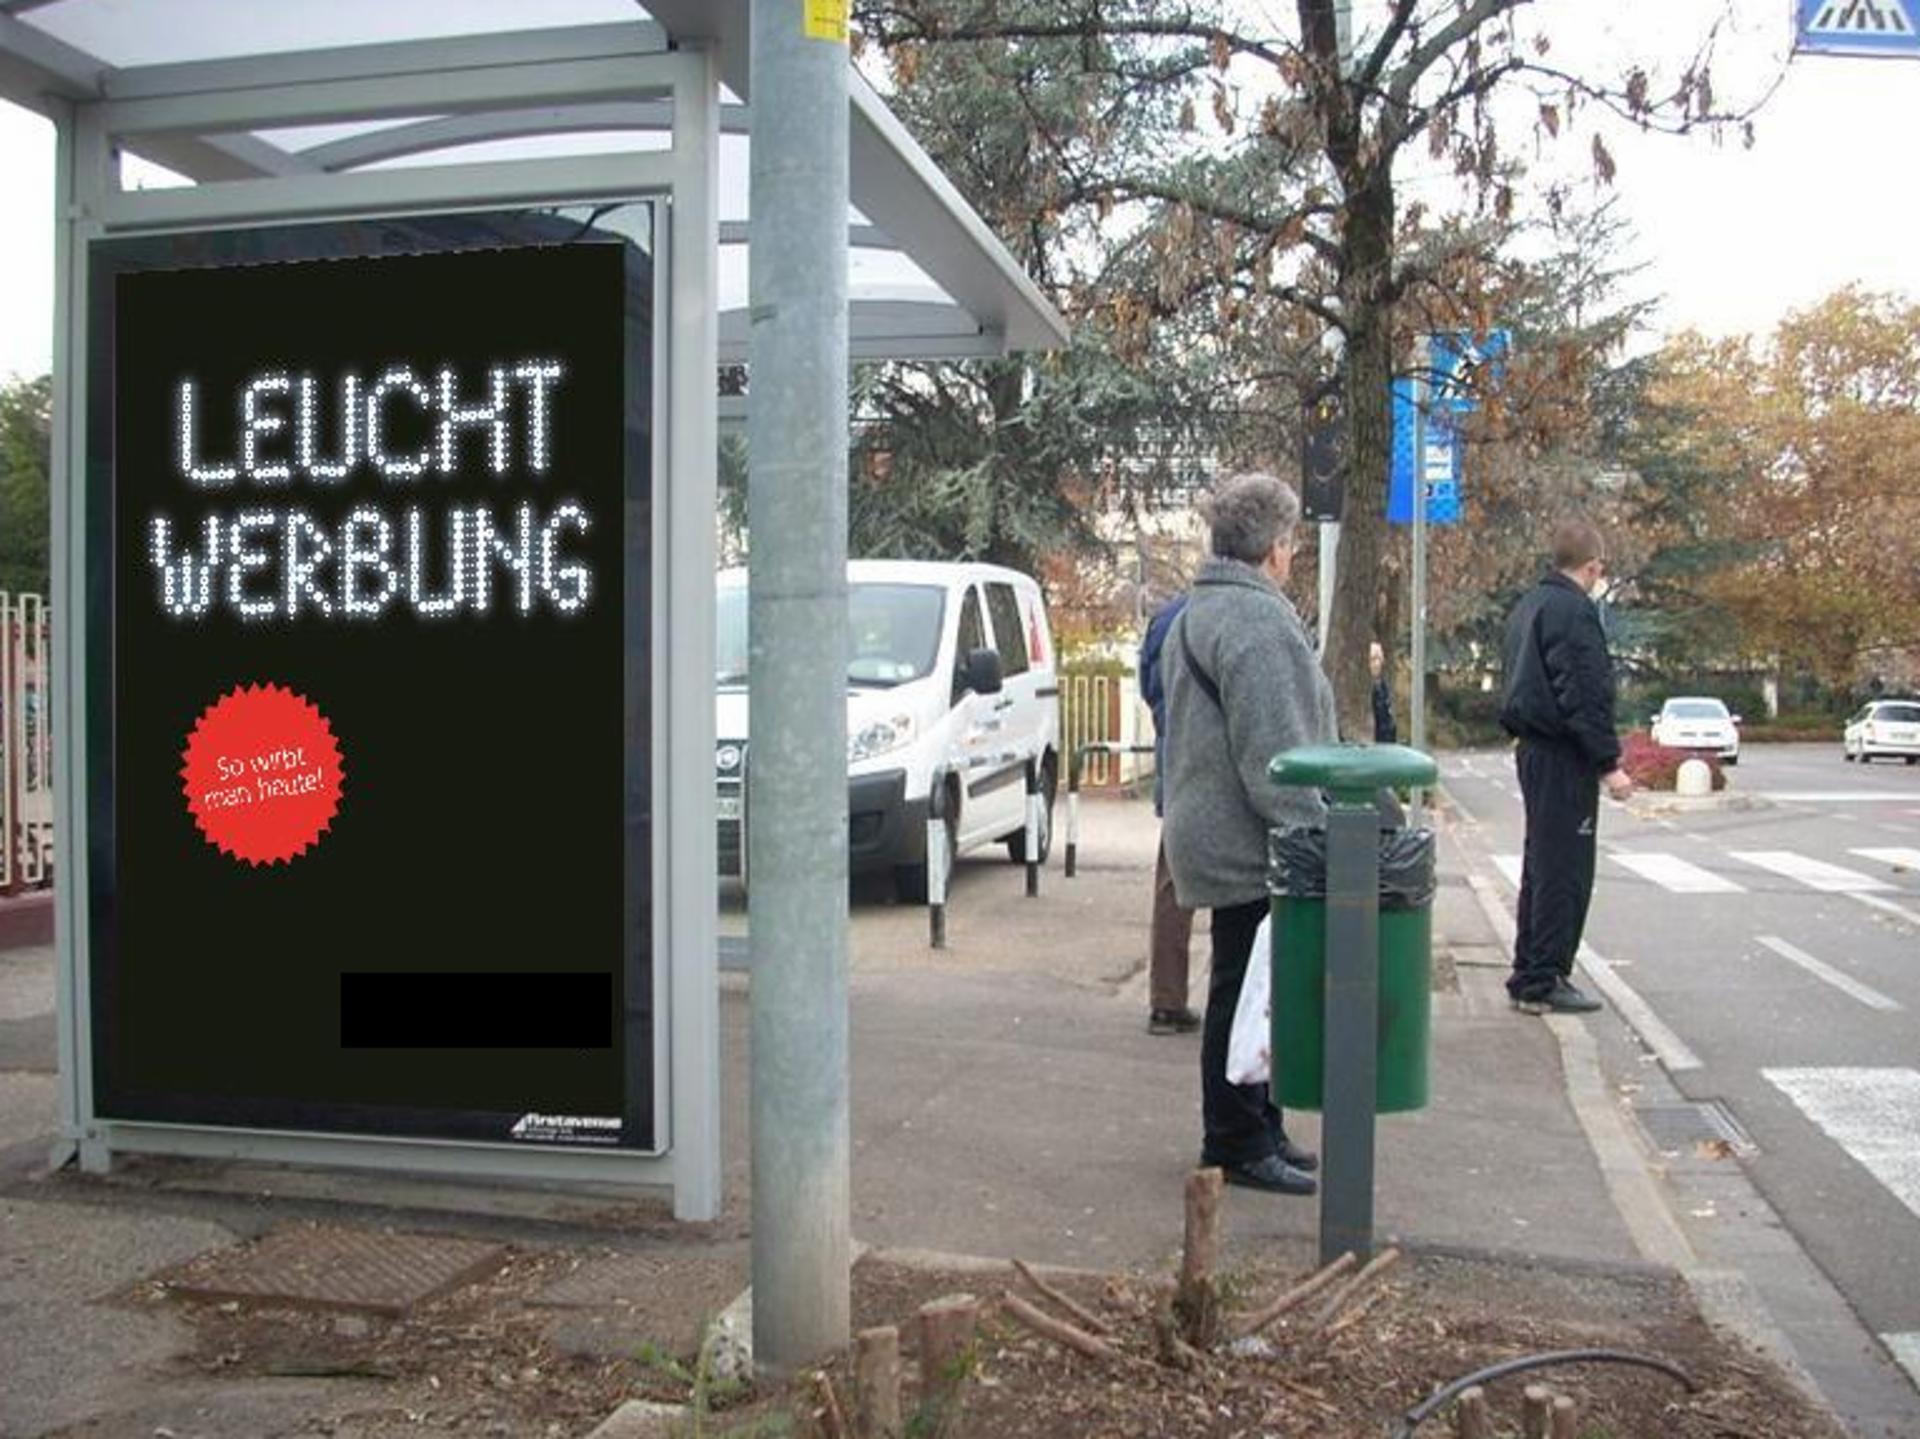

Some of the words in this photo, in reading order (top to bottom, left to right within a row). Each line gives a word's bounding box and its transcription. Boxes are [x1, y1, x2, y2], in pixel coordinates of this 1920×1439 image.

[178, 361, 563, 482] LEUCHT
[150, 501, 592, 617] WERBUNG
[205, 786, 252, 811] man
[257, 766, 325, 801] heute!
[217, 756, 244, 781] So
[251, 747, 307, 773] wirbt
